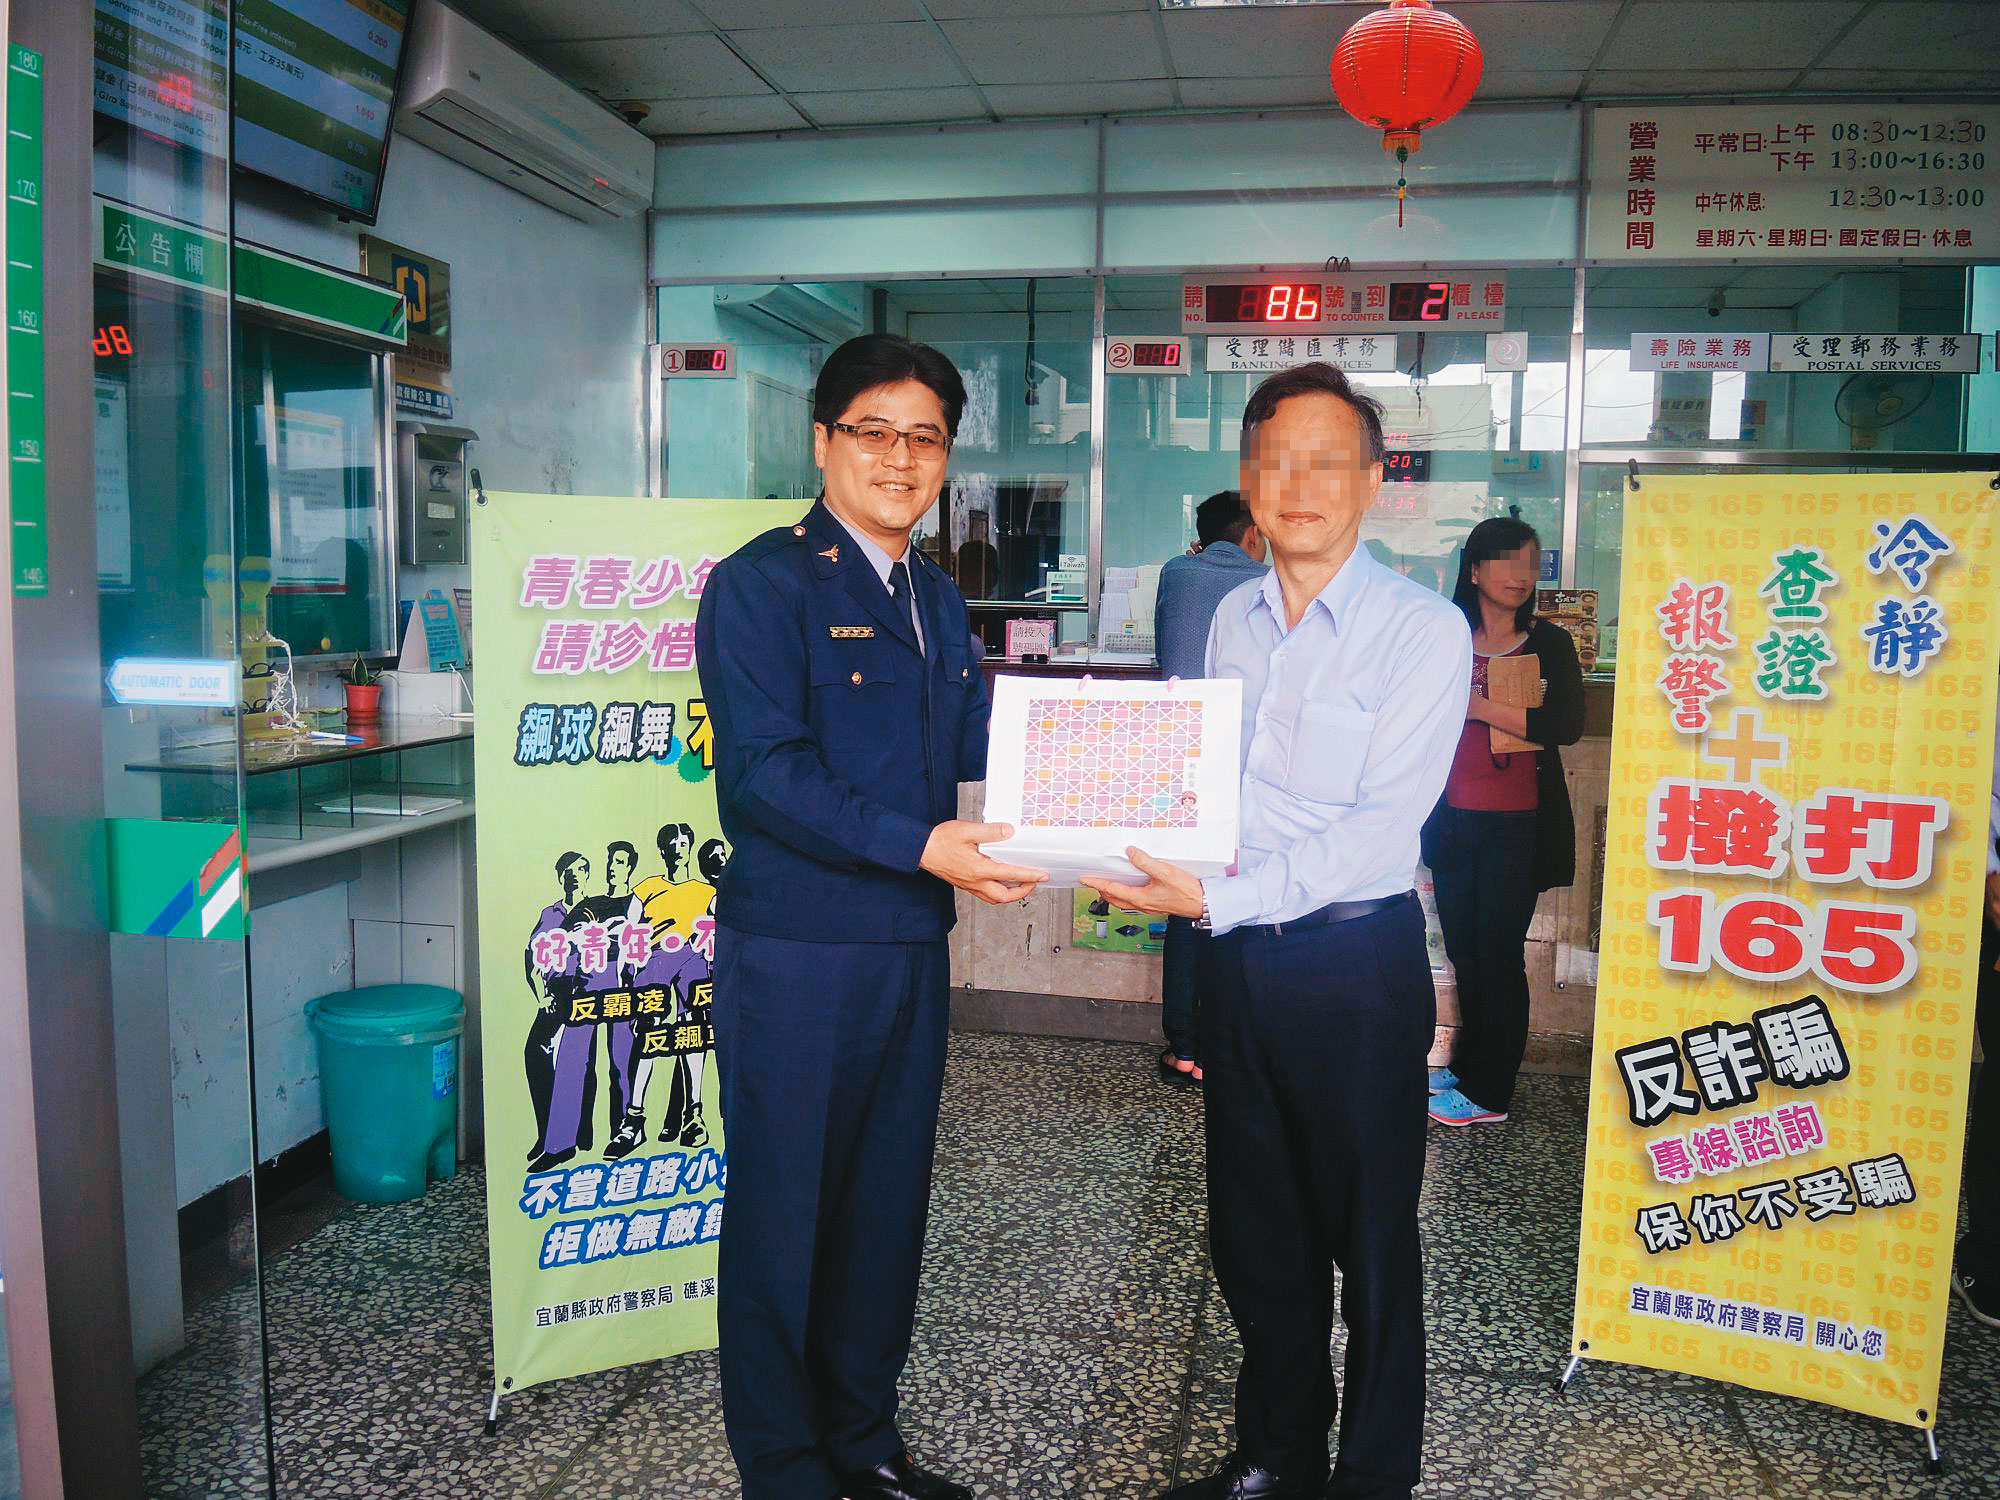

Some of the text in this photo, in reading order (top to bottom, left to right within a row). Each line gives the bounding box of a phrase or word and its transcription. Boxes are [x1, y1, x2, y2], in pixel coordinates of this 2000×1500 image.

[17, 50, 38, 71] 180
[1770, 123, 1816, 145] 上午
[1770, 148, 1986, 172] 下午 13:00~16:30
[16, 178, 37, 198] 170
[1625, 121, 1659, 250] 營業時間
[1829, 186, 1985, 209] 12:30~13:00
[115, 222, 204, 275] 公告欄
[1184, 285, 1203, 308] 請
[1420, 283, 1448, 320] 2
[17, 308, 38, 328] 160
[1185, 314, 1204, 322] NO.
[1326, 312, 1385, 322] TO COUNTER
[1457, 312, 1499, 320] PLEASE
[1226, 337, 1378, 358] 受理儲匯業務
[1650, 338, 1752, 358] 壽險業務
[1793, 335, 1961, 359] 受理郵務業務
[1660, 361, 1739, 369] LIFE INSURANCE
[1808, 361, 1942, 371] POSTAL SERVICES
[19, 439, 39, 457] 150
[1638, 490, 1996, 516] 165 165 165 165 165
[1634, 526, 1689, 548] 165
[1704, 527, 1761, 549] 165
[22, 567, 43, 584] 140
[1863, 518, 1950, 672] 冷靜
[1756, 549, 1834, 696] 查證
[536, 621, 697, 670] 請珍惜
[1660, 581, 1732, 729] 報警
[120, 674, 221, 689] AUTOMATIC DOOR
[1924, 673, 1983, 698] 165
[1842, 705, 1897, 730] 165
[1920, 708, 1981, 732] 165
[1621, 727, 1676, 751] 165
[1839, 741, 1894, 766] 165
[1917, 743, 1977, 769] 165
[1656, 784, 1936, 880] 撥打
[1658, 894, 1906, 985] 165
[1608, 964, 1665, 990] 165
[569, 989, 665, 1022] 反霸凌
[1604, 997, 1659, 1023] 165
[1903, 996, 1961, 1025] 165
[642, 1025, 715, 1054] 反飆
[1896, 1033, 1957, 1061] 165
[1621, 1002, 1844, 1120] 反詐騙
[1895, 1069, 1954, 1097] 165
[1890, 1103, 1950, 1132] 165
[1650, 1105, 1825, 1181] 專線諮詢
[524, 1152, 727, 1216] 不當道路小
[1593, 1158, 1646, 1185] 165
[1638, 1156, 1915, 1251] 保你不受騙
[1585, 1227, 1935, 1280] 165 165 165 165
[1653, 1266, 1708, 1293] 165
[1723, 1279, 1778, 1307] 165
[1800, 1259, 1857, 1289] 165
[1874, 1272, 1932, 1302] 165
[535, 1277, 716, 1327] 宜蘭縣政府警察局 礁溪
[1580, 1318, 1633, 1345] 165
[1630, 1286, 1884, 1357] 宜蘭縣政府警察局 關心您
[1648, 1331, 1701, 1361] 165
[1717, 1344, 1920, 1405] 165 165 165
